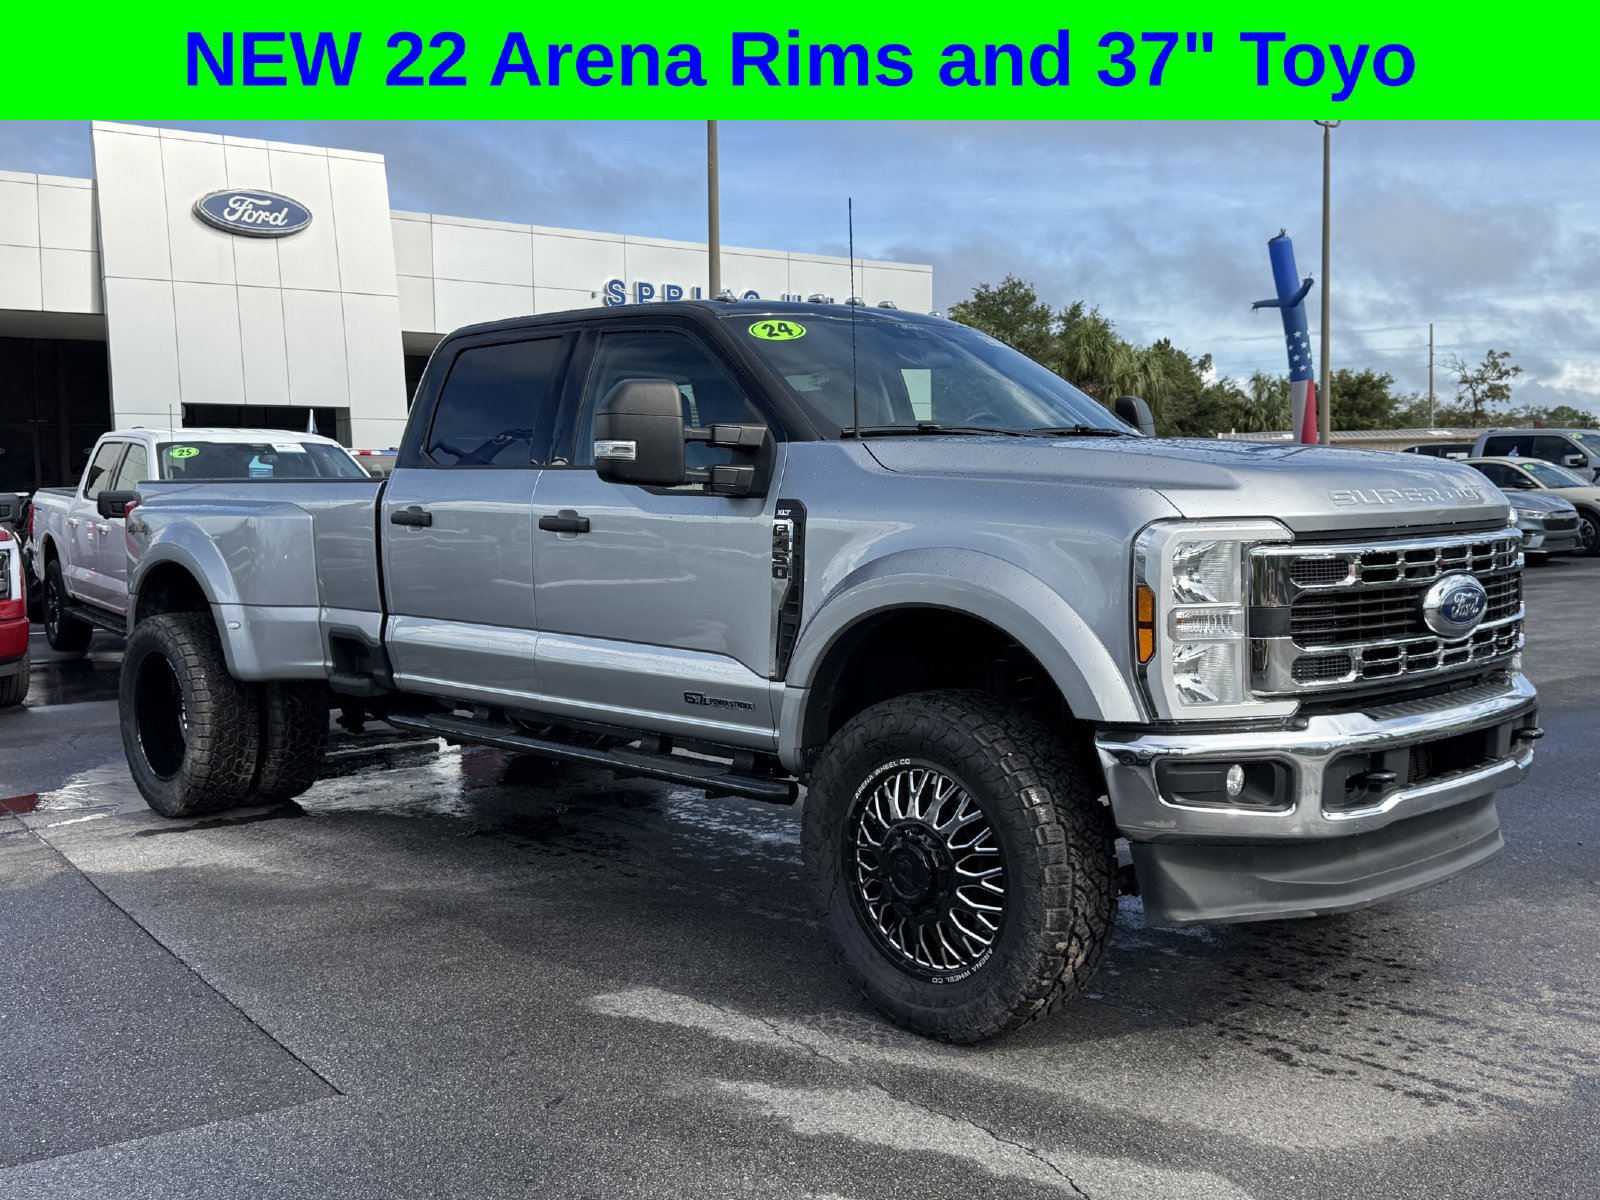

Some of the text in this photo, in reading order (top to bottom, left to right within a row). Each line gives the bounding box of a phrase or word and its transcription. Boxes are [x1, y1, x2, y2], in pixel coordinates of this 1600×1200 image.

[223, 195, 288, 226] Ford
[761, 322, 793, 337] 24
[177, 448, 192, 457] 25
[1328, 487, 1444, 506] SUPER
[1451, 592, 1479, 619] Ford
[854, 758, 911, 799] ARENA WHEEL CO
[931, 947, 993, 984] ARENA WHEEL CO
